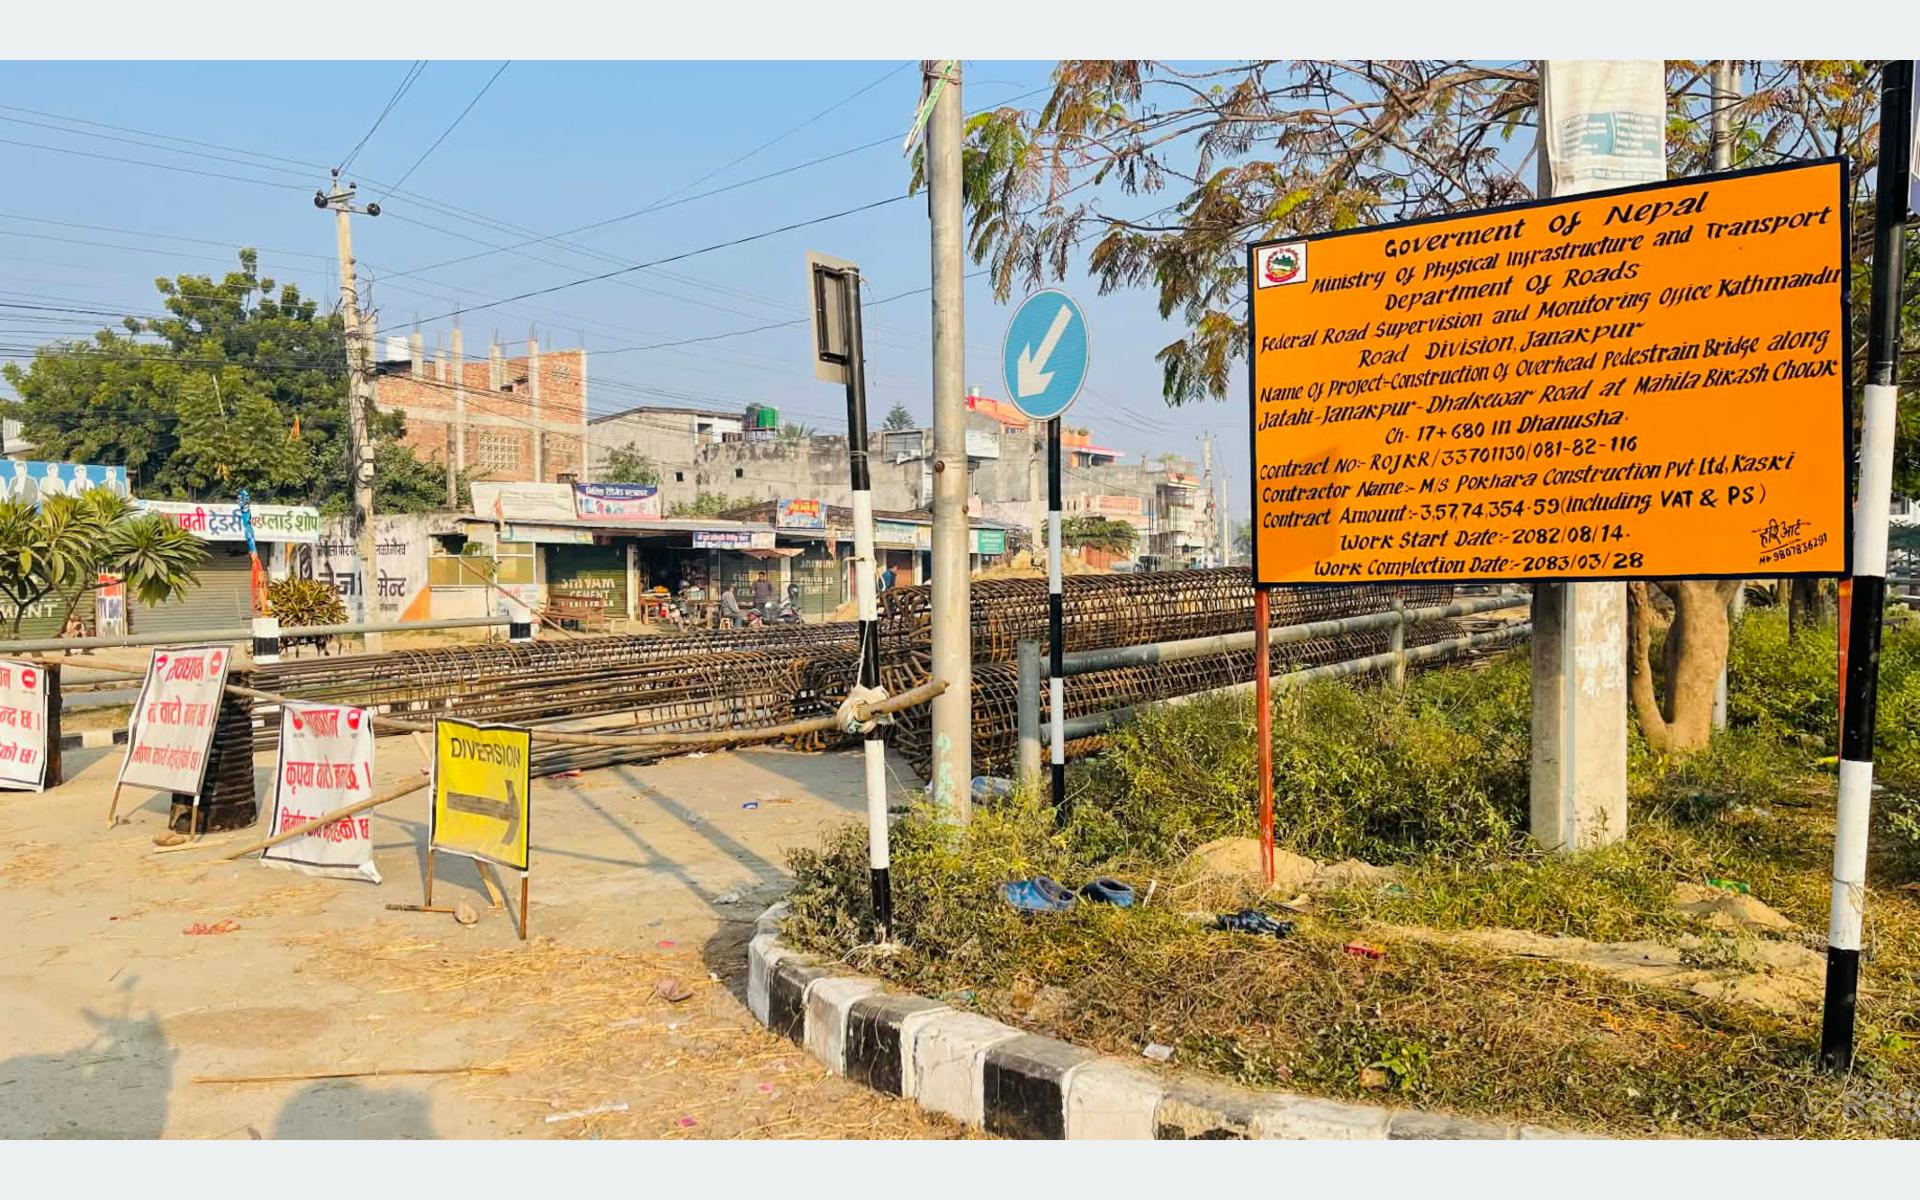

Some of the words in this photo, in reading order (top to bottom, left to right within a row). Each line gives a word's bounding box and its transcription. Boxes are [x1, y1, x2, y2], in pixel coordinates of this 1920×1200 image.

[1385, 218, 1526, 258] Goverment
[1548, 211, 1581, 237] Of
[1603, 191, 1709, 226] Nepal
[1311, 271, 1386, 293] Ministry
[1395, 267, 1415, 286] Of
[1423, 253, 1500, 281] Physical
[1506, 235, 1645, 268] Infrastructure
[1653, 224, 1694, 247] and
[1707, 206, 1832, 239] Transport
[1384, 276, 1513, 312] Department
[1525, 274, 1552, 296] Of
[1563, 260, 1640, 288] Roads
[1261, 330, 1318, 353] Federal
[1321, 322, 1370, 345] Road
[1375, 312, 1483, 339] Supervision
[1492, 304, 1530, 324] and
[1537, 292, 1651, 319] Monitoring
[1659, 284, 1713, 306] Office
[1717, 265, 1841, 297] Kathmandu
[1260, 386, 1304, 403] Name
[1307, 382, 1324, 402] Of
[1493, 362, 1509, 383] Of
[1515, 352, 1598, 377] Overhead
[1702, 335, 1760, 358] Bridge
[1767, 329, 1831, 355] along
[1358, 343, 1409, 368] Road
[1538, 379, 1594, 404] Road
[1599, 377, 1627, 397] at
[1633, 371, 1702, 394] Mahila
[1702, 362, 1770, 388] Bikash
[1772, 359, 1838, 382] Chowk
[1260, 456, 1330, 481] Contract
[1262, 482, 1351, 504] Contractor
[1455, 472, 1538, 493] Pokhara
[1543, 462, 1662, 486] Construction
[1263, 508, 1332, 529] Contract
[1661, 489, 1694, 508] VAT
[1699, 488, 1717, 508] &
[1341, 534, 1394, 551] Work
[1399, 530, 1449, 549] Start
[1314, 561, 1362, 576] Work
[451, 738, 521, 768] DIVERSION
